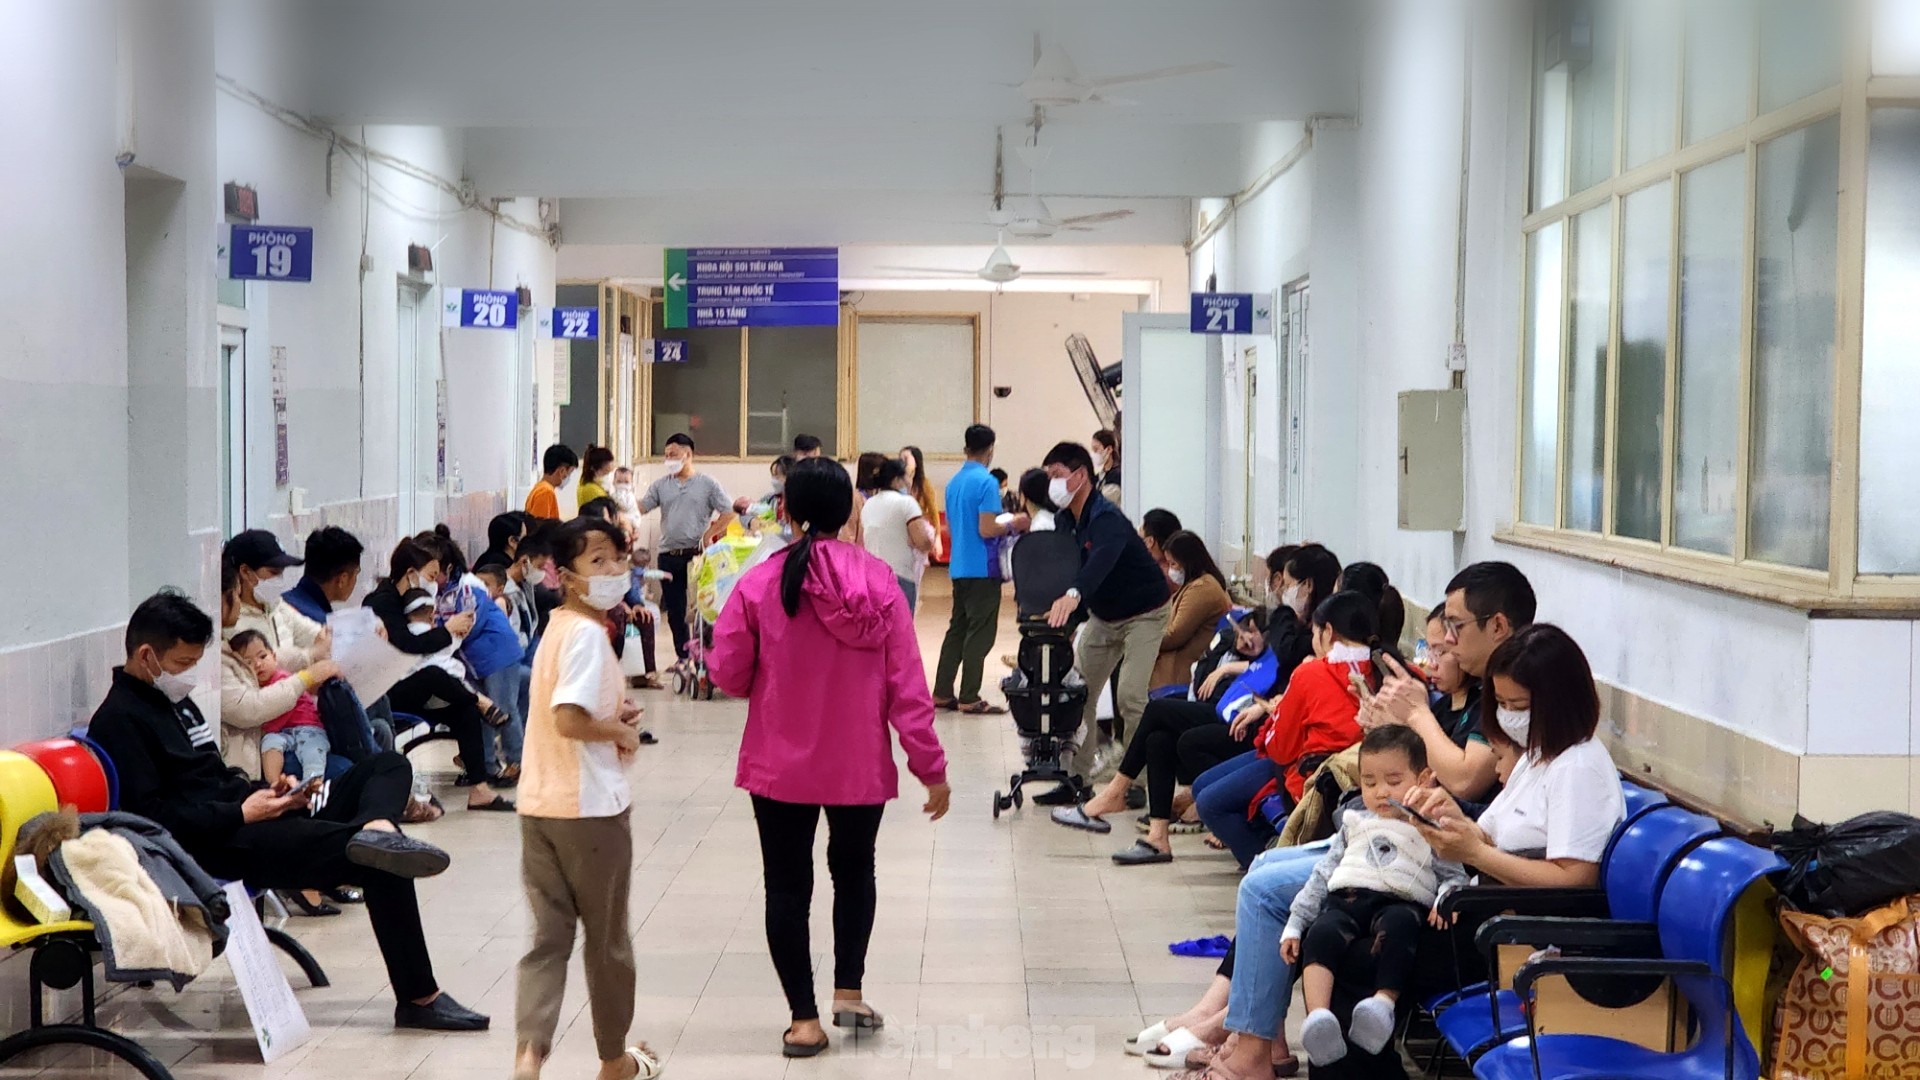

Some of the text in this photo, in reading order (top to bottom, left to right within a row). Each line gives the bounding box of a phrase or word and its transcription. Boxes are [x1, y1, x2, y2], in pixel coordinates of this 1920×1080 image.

[248, 230, 297, 247] PHÒNG
[251, 245, 292, 277] 19
[697, 262, 718, 272] KHOA
[734, 262, 748, 273] SOI
[697, 285, 722, 297] TRUNG
[723, 284, 741, 296] TÂM
[473, 292, 508, 305] PHÒNG
[1203, 296, 1240, 309] PHÒNG
[473, 303, 506, 327] 20
[697, 306, 713, 318] NHÀ
[1206, 307, 1235, 331] 21
[562, 318, 589, 337] 22
[662, 346, 682, 361] 24
